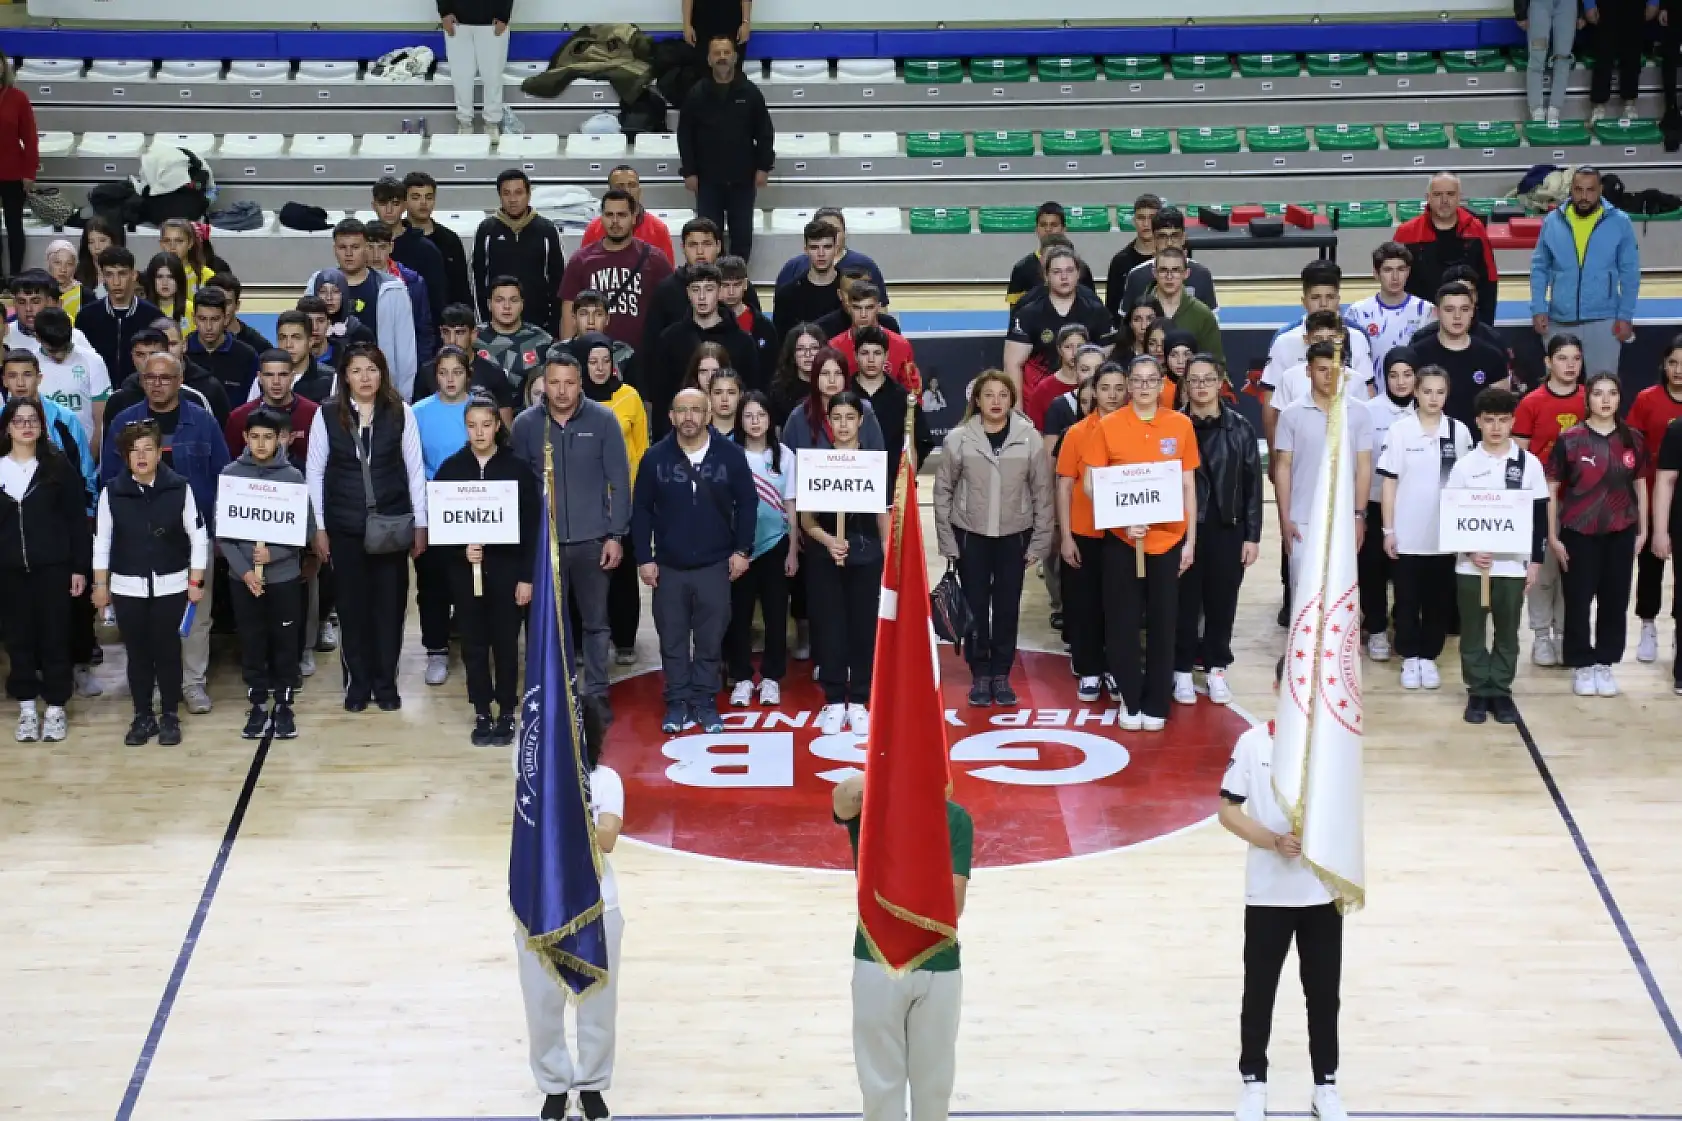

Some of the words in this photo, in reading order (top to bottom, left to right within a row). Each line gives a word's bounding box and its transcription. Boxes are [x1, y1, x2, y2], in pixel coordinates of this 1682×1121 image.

[608, 292, 639, 317] ESS
[808, 478, 875, 493] ISPARTA
[1115, 488, 1161, 508] İZMİR
[228, 505, 295, 525] BURDUR
[443, 506, 503, 524] DENİZLİ
[1456, 517, 1515, 532] KONYA
[988, 708, 1118, 728] HEP
